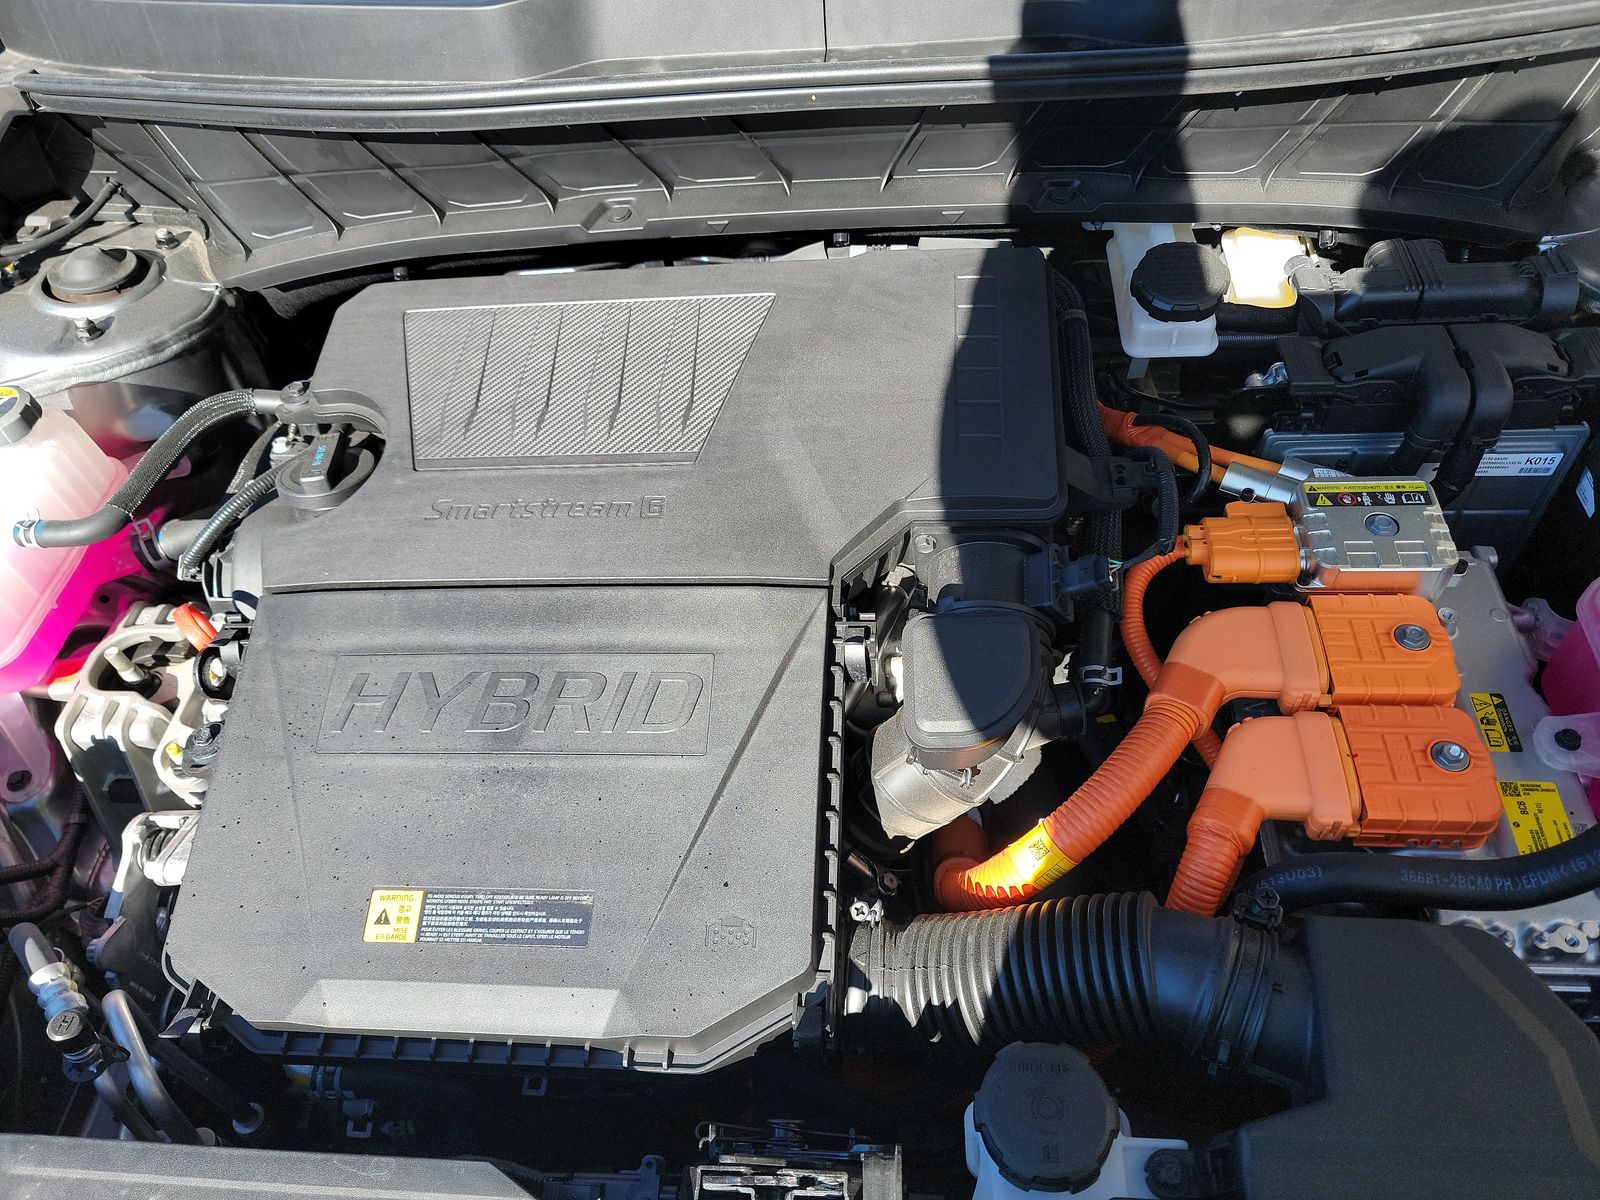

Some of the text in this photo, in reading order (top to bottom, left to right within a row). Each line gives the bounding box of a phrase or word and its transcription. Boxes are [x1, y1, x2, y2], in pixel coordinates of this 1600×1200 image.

[1525, 456, 1557, 466] K015
[424, 495, 666, 521] Smartstream G
[329, 670, 705, 734] HYBRID
[379, 894, 415, 902] WARNING
